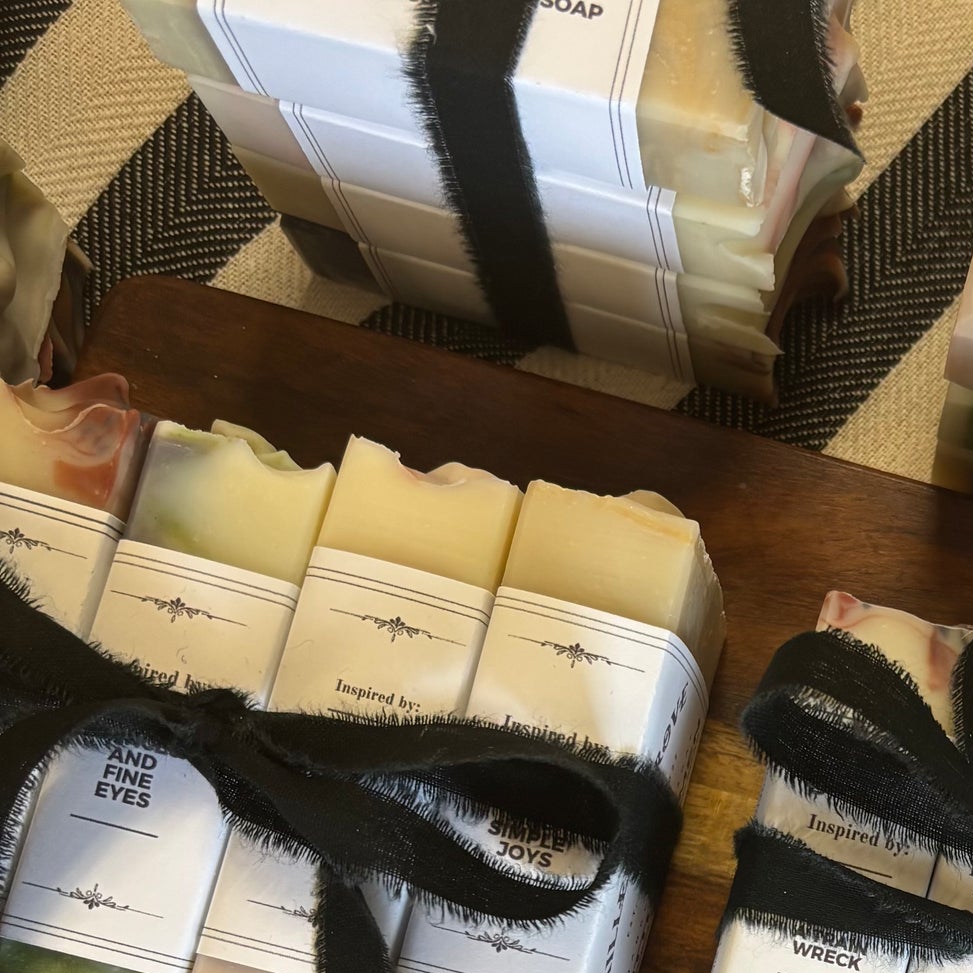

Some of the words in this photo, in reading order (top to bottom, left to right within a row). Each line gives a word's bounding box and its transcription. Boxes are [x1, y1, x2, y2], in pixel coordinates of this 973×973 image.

[334, 678, 396, 706] Inspired
[399, 695, 421, 714] by:
[107, 747, 158, 771] AND
[102, 764, 153, 790] FINE
[94, 780, 152, 809] EYES
[487, 819, 565, 853] SIMPLE
[807, 813, 880, 847] Inspired
[885, 837, 911, 857] by:
[496, 840, 553, 868] JOYS
[793, 940, 862, 972] WRECK
